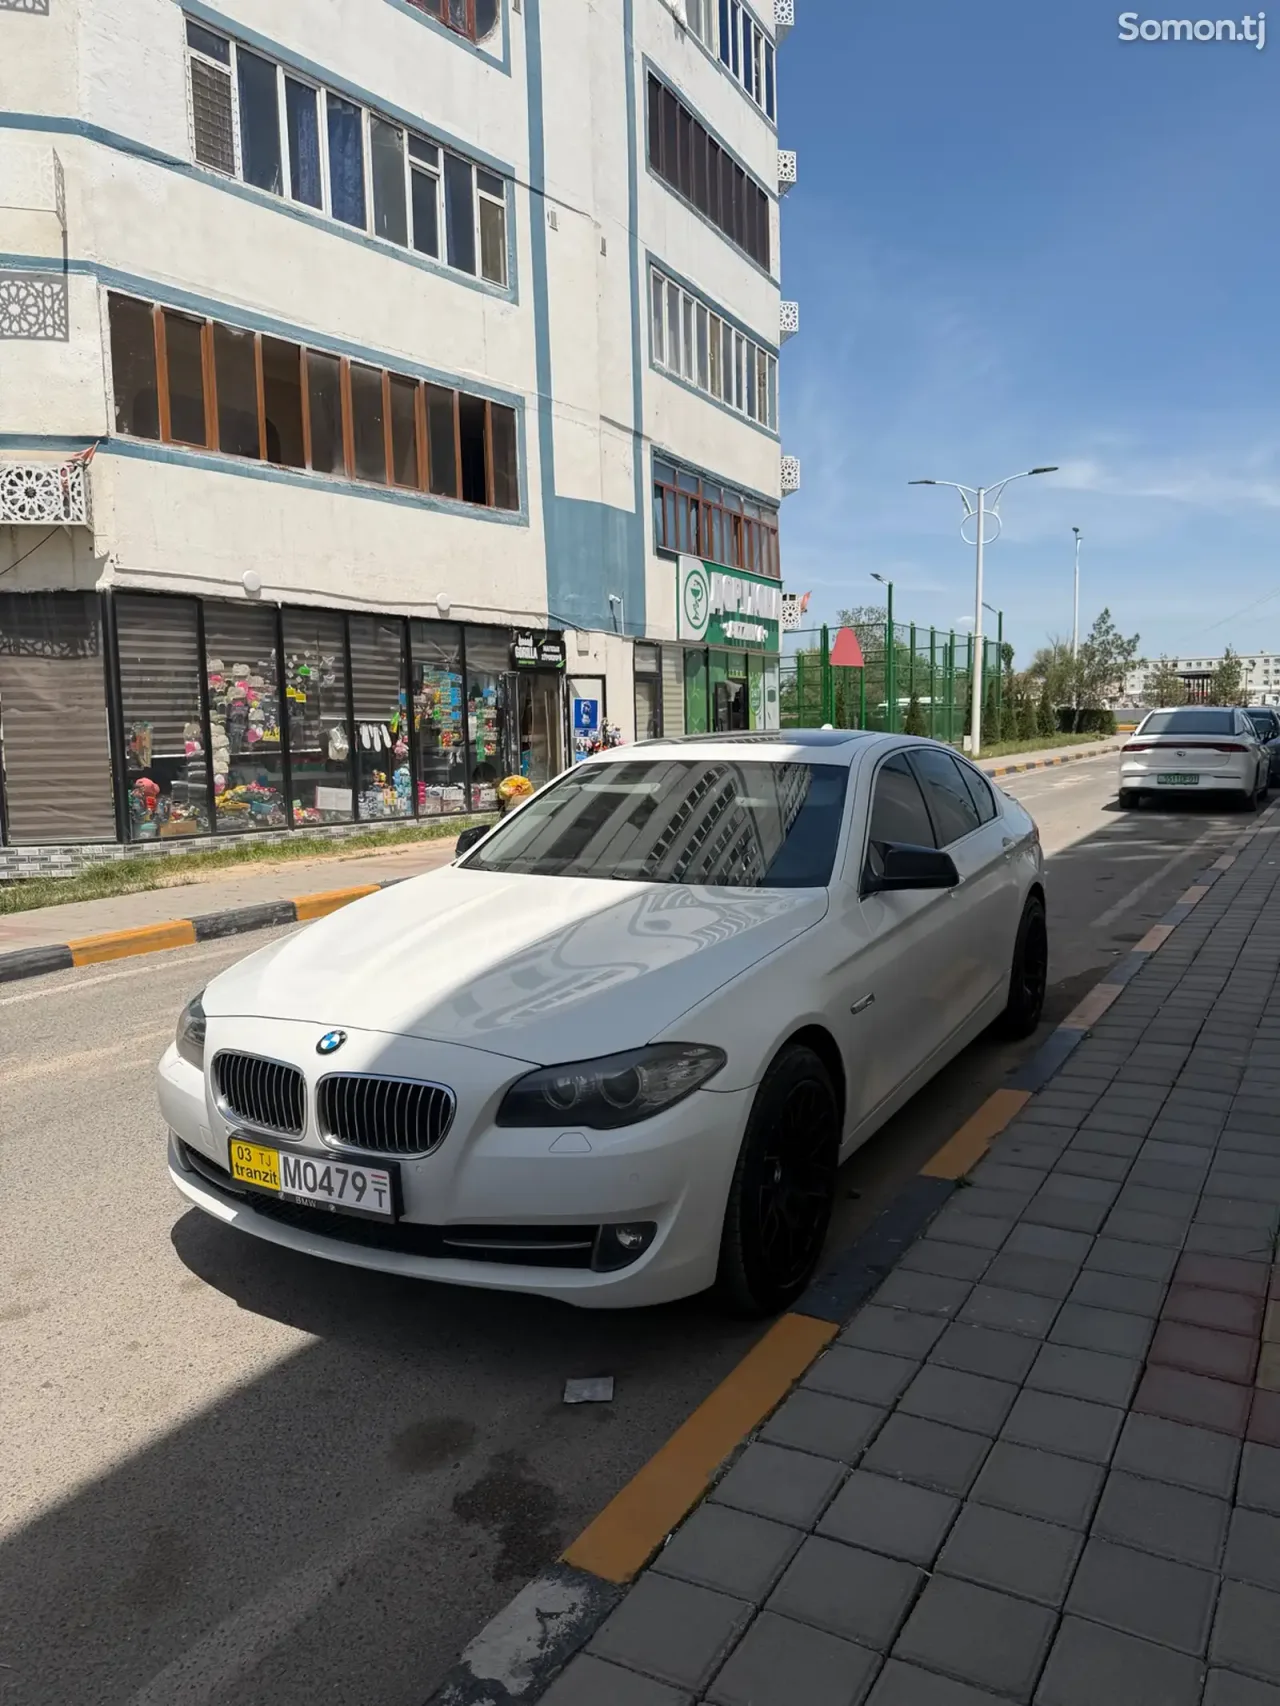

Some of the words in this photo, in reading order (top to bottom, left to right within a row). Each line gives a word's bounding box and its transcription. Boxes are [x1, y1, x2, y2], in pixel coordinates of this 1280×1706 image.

[237, 1145, 252, 1162] 03
[235, 1162, 279, 1186] tranzit
[283, 1156, 367, 1203] M0479
[295, 1196, 317, 1208] BMW
